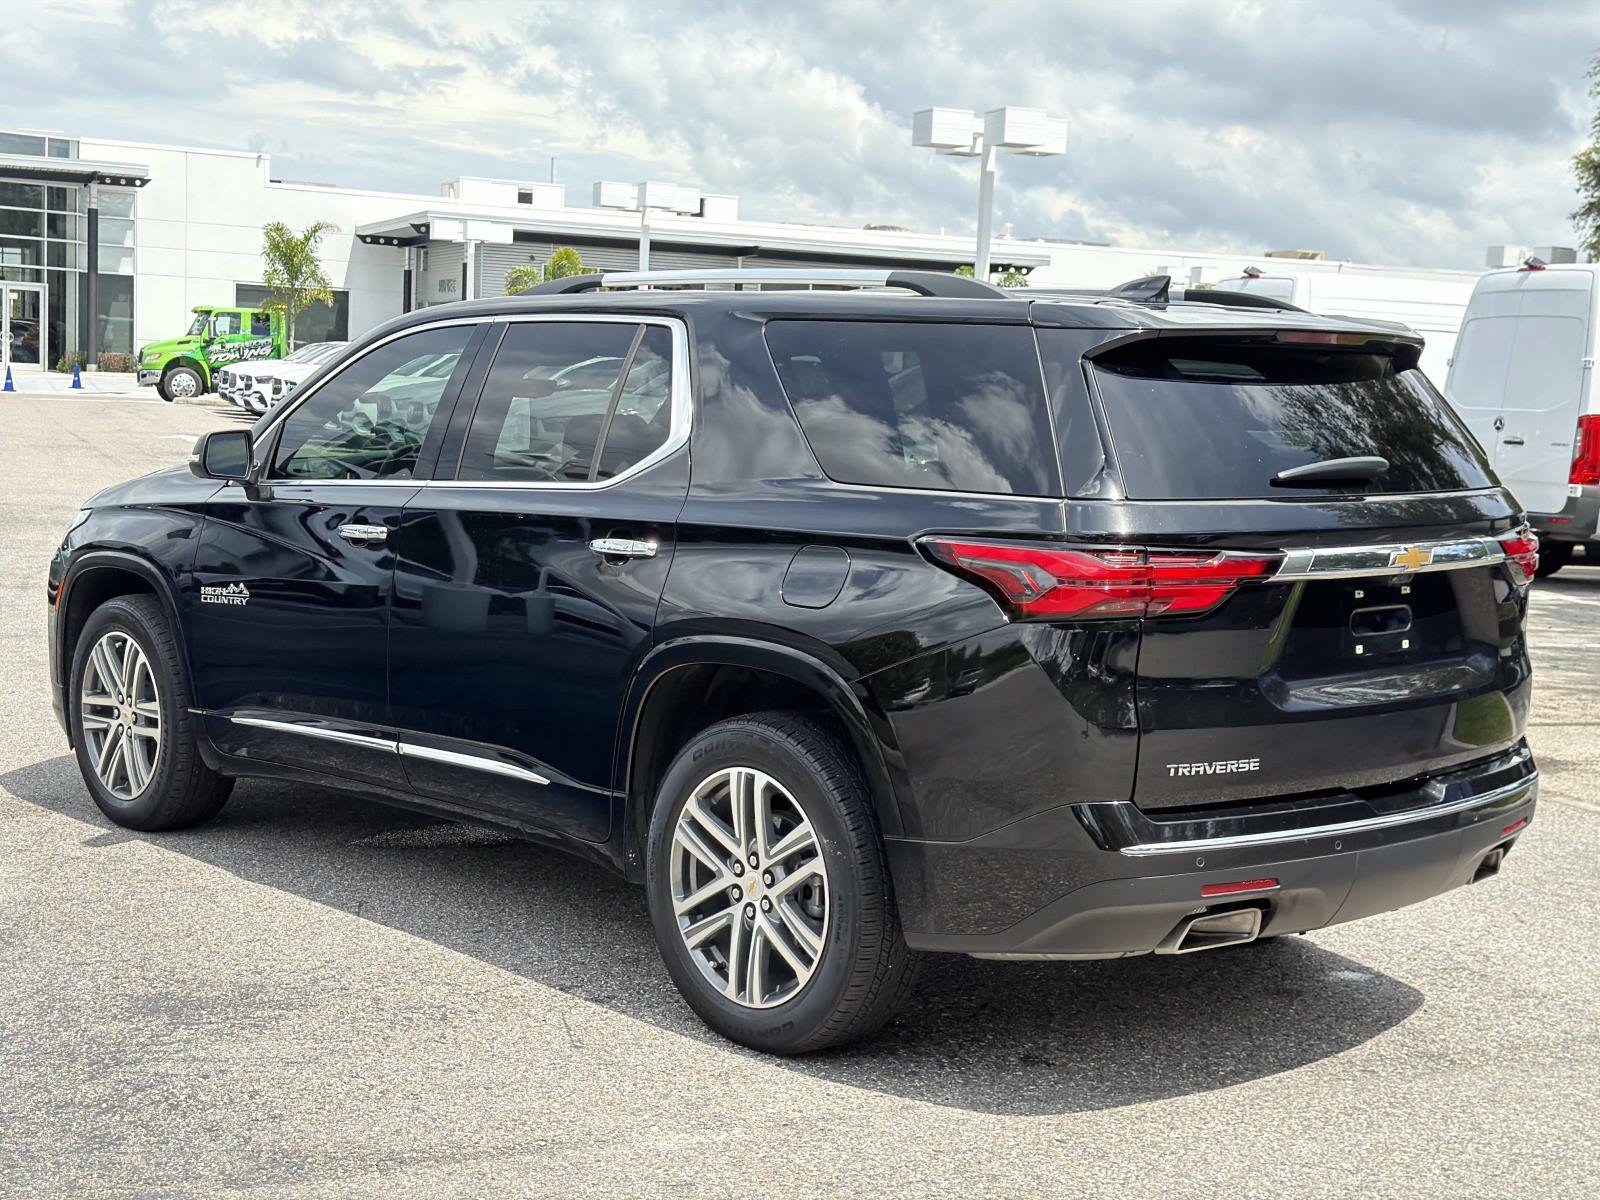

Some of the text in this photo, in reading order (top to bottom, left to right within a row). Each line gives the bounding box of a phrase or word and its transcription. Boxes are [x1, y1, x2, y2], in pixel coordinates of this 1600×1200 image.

[208, 346, 274, 364] TOWING
[201, 586, 227, 595] HIGH
[201, 594, 249, 605] COUNTRY
[1166, 758, 1260, 777] TRAVERSE
